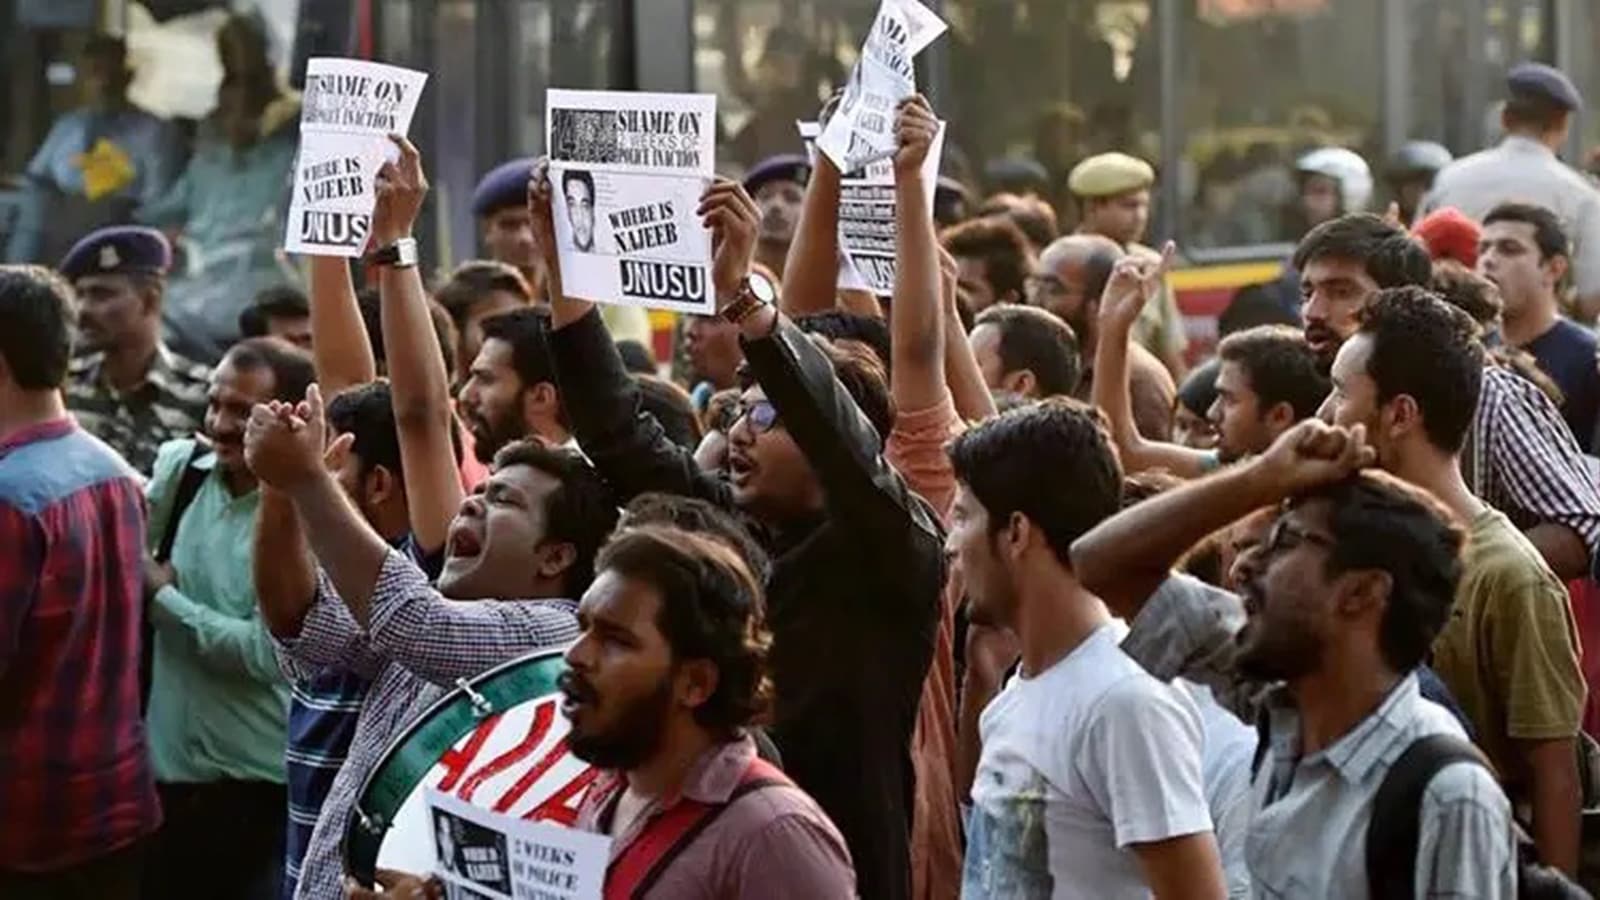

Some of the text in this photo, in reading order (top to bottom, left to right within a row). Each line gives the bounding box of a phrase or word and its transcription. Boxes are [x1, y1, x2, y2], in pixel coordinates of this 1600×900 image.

[316, 74, 409, 103] SHAME ON
[616, 109, 702, 137] SHAME ON
[303, 155, 361, 181] WHERE IS
[651, 150, 701, 168] INACTION
[303, 175, 364, 204] NAJEEB
[608, 201, 675, 229] WHERE IS
[614, 222, 678, 255] NAJEEB
[622, 261, 704, 300] JNUSU
[525, 841, 577, 868] WEEKS
[526, 864, 580, 893] POLICE
